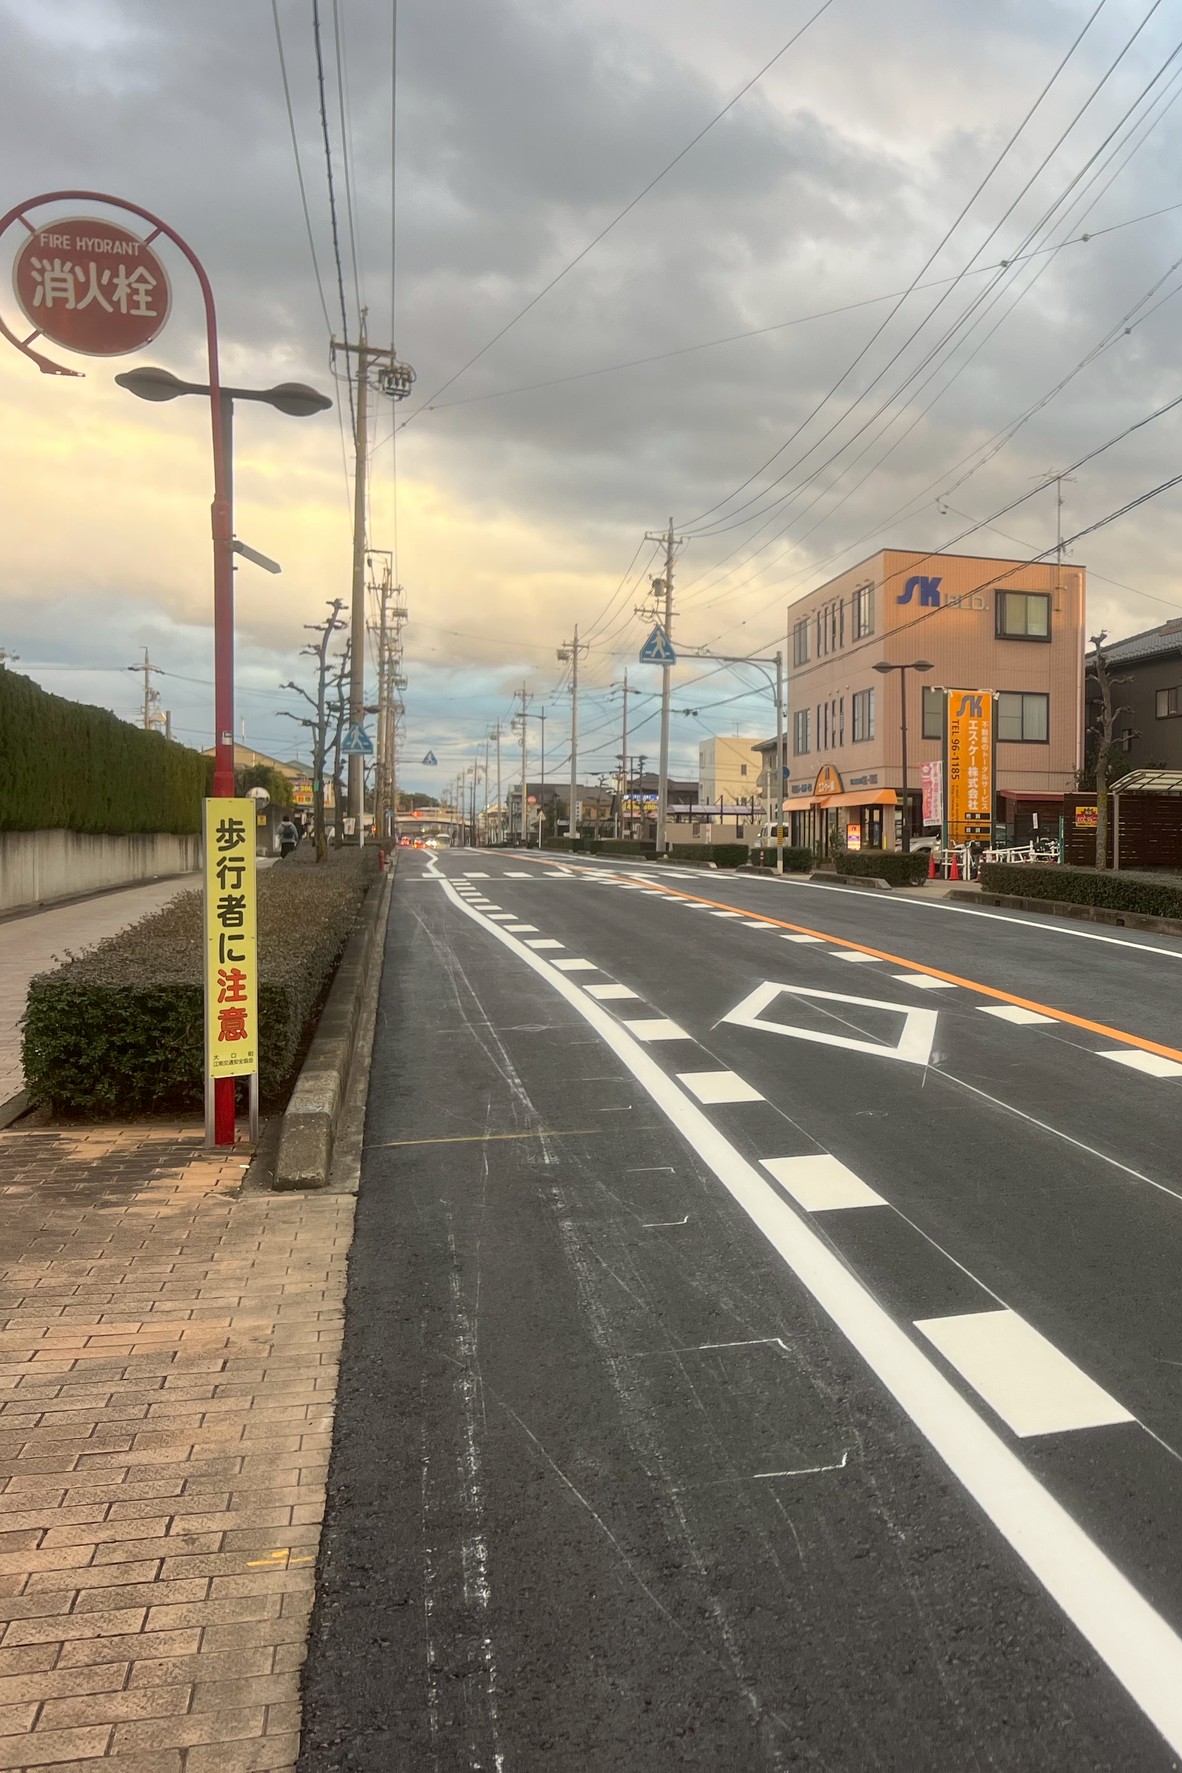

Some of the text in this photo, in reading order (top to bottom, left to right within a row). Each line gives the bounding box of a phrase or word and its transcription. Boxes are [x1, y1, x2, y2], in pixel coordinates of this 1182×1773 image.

[40, 233, 140, 256] FIRE HYDRANT
[30, 256, 158, 317] 消火栓
[896, 575, 943, 607] SK
[956, 694, 983, 718] SK
[951, 719, 960, 780] TEL 96-1185
[968, 720, 979, 810] エス・ケー株式会社
[216, 818, 248, 1042] 歩行者に注意
[213, 1051, 254, 1060] 大口町
